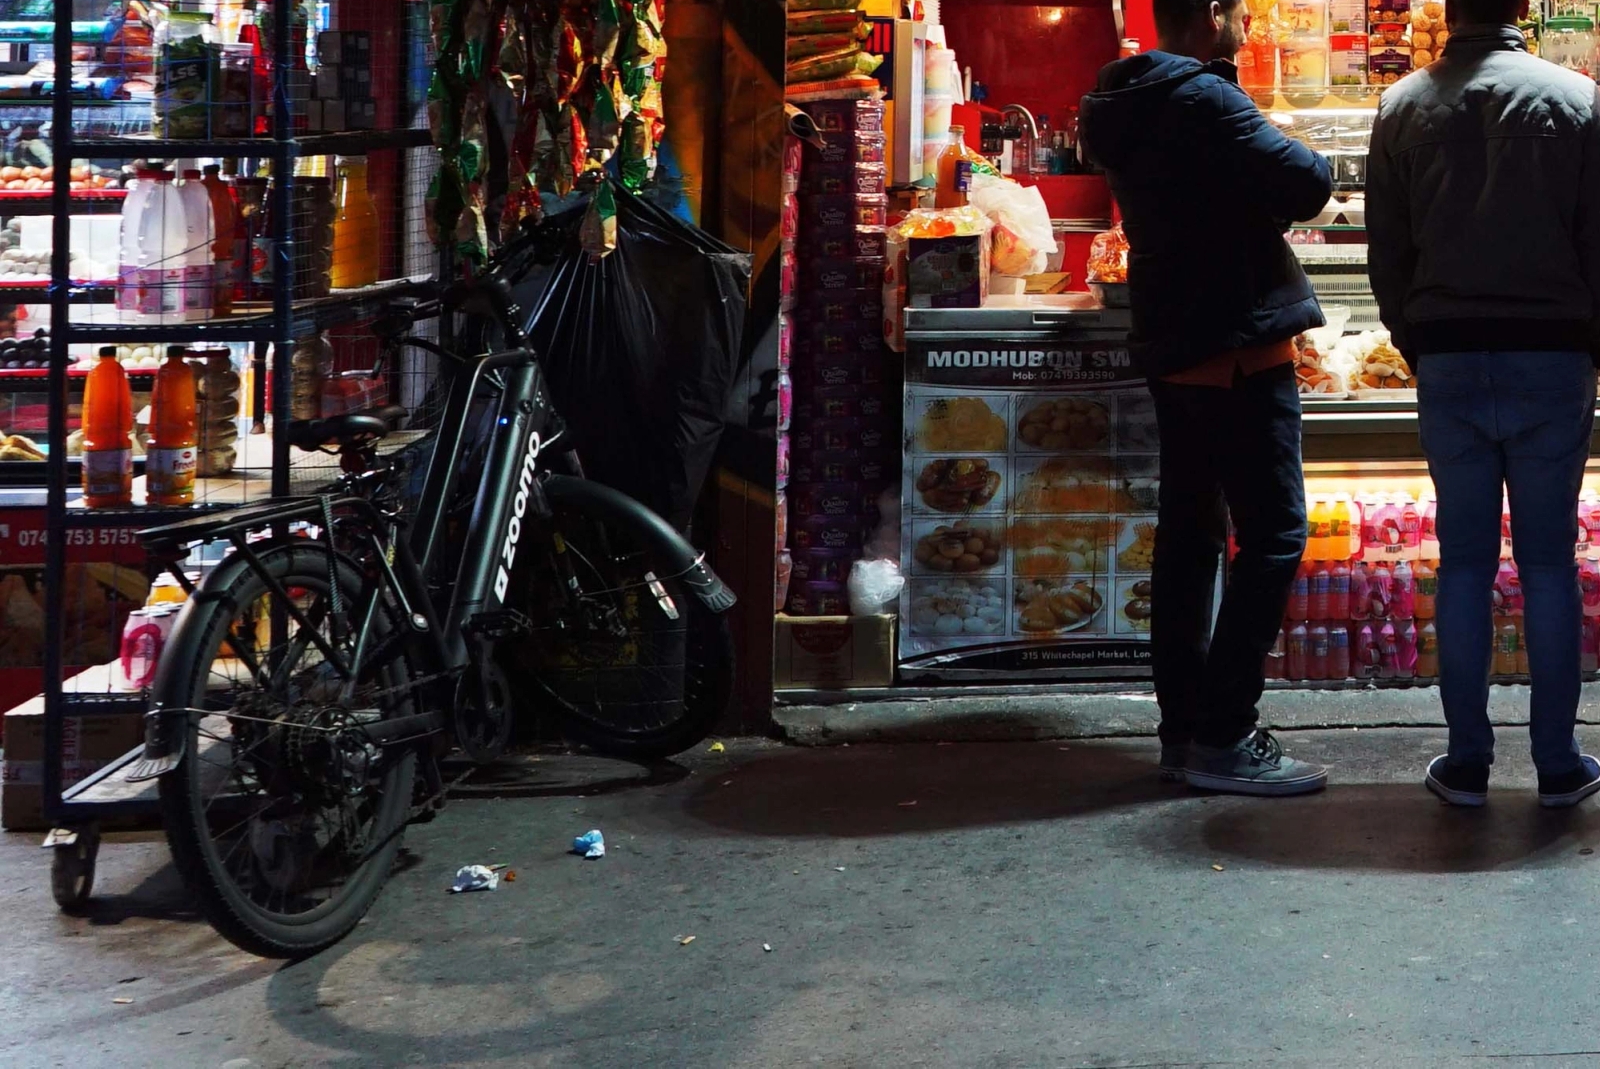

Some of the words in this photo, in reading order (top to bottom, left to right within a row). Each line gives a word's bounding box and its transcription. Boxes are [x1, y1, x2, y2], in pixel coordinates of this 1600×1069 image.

[927, 350, 1082, 368] MODHUBON
[1012, 371, 1037, 381] Mob:
[1040, 371, 1115, 381] 07419393590
[502, 431, 540, 569] zoomo
[66, 530, 94, 545] 753
[1021, 651, 1039, 661] 315
[1042, 649, 1095, 661] Whitechapel
[1133, 649, 1151, 659] Lon
